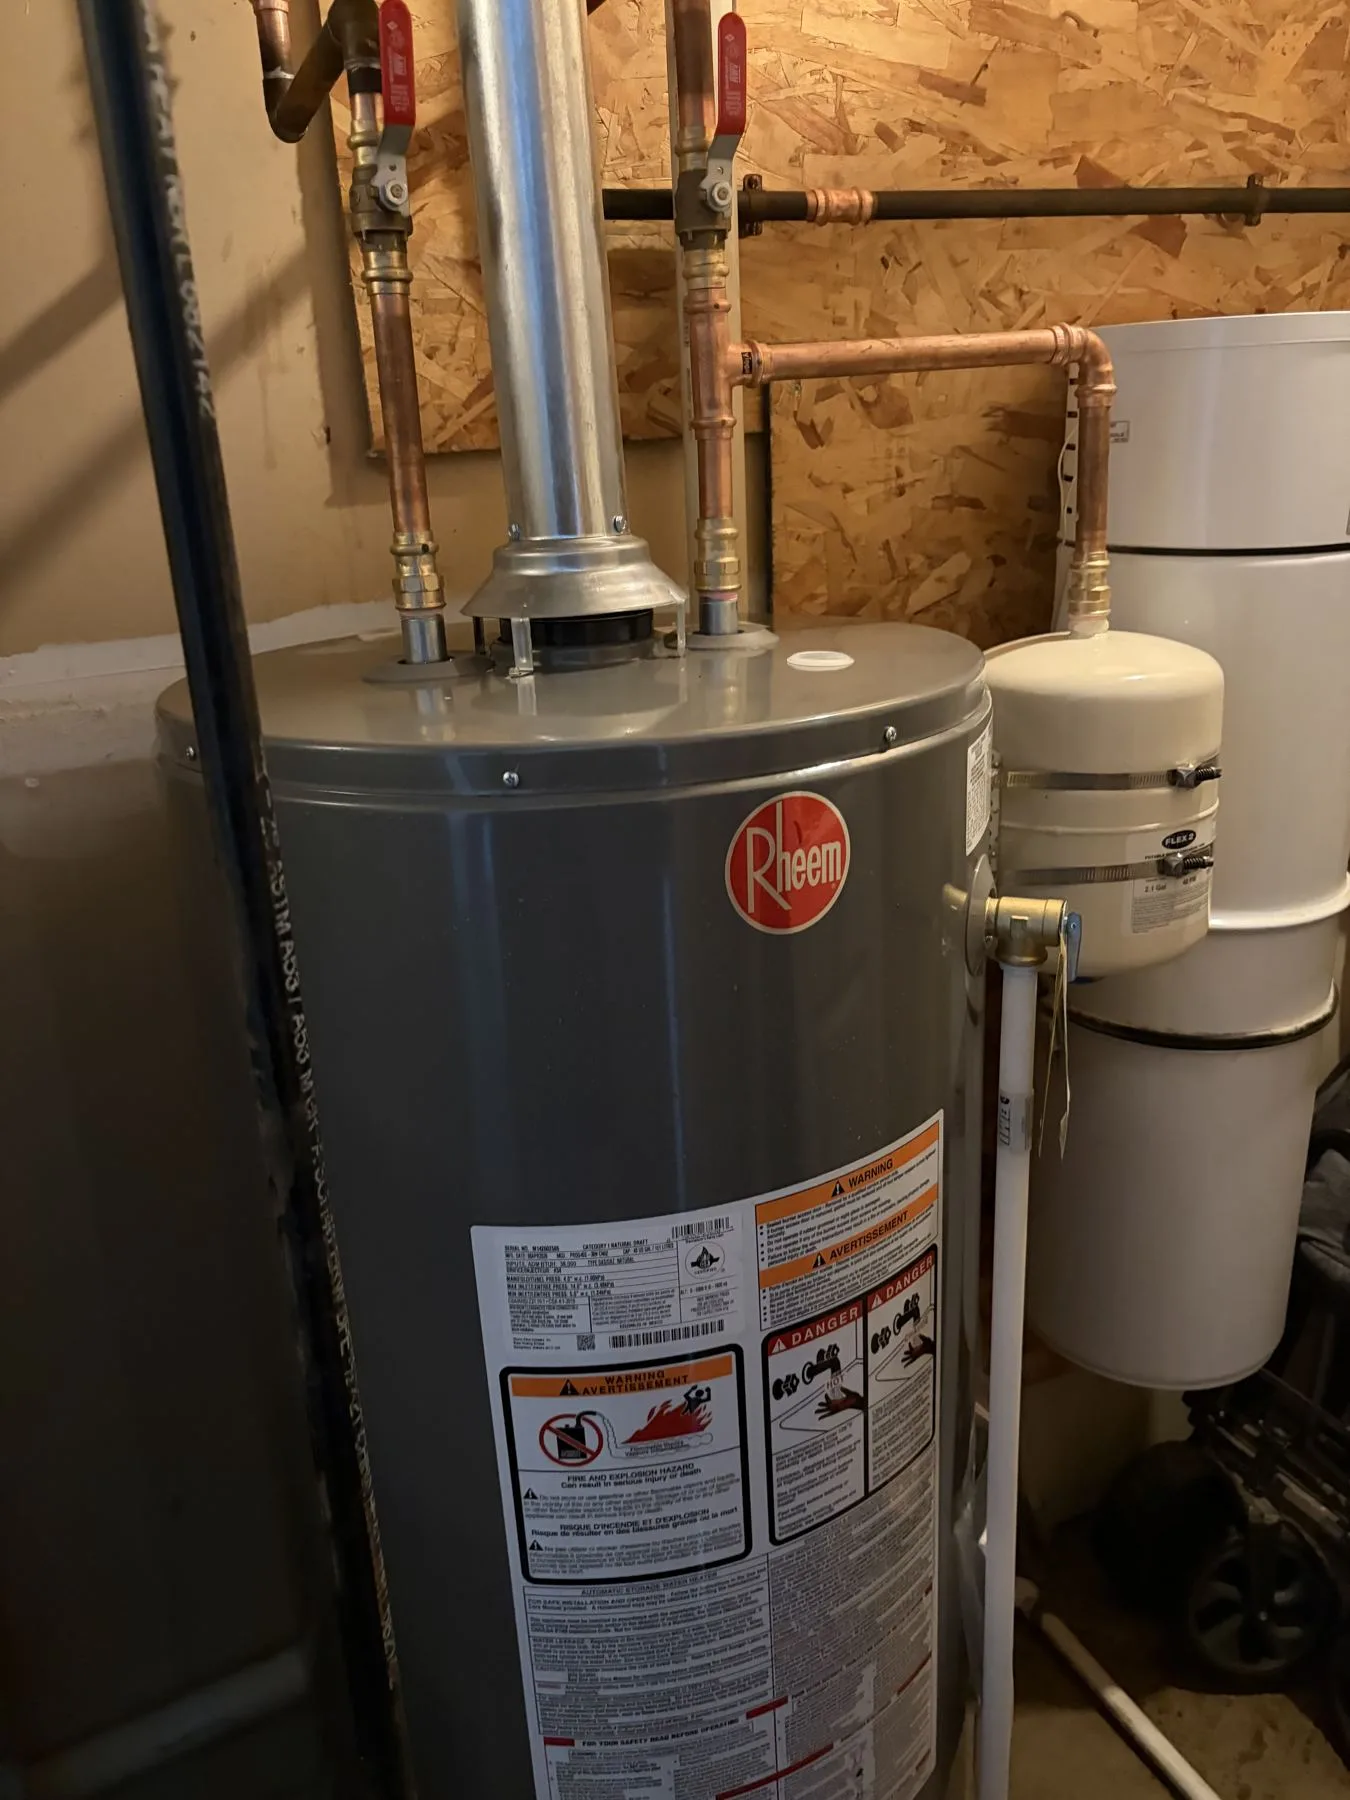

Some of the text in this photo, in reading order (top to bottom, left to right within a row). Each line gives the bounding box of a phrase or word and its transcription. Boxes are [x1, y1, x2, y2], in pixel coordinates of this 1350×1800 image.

[746, 800, 842, 914] Rheem
[848, 1158, 893, 1188] WARNING
[830, 1210, 908, 1260] AVERTISSEMENT
[886, 1255, 933, 1299] DANGER
[791, 1307, 858, 1347] DANGER
[582, 1375, 688, 1395] AVERTISSEMENT
[604, 1370, 665, 1385] WARNING
[561, 1481, 577, 1489] Can
[613, 1478, 643, 1486] serious
[644, 1475, 667, 1484] injury
[679, 1468, 701, 1477] death
[589, 1474, 607, 1482] AND
[609, 1468, 658, 1480] EXPLOSION
[659, 1463, 694, 1474] HAZARD
[531, 1529, 558, 1538] Risque
[672, 1518, 697, 1529] graves
[720, 1506, 738, 1517] mort
[560, 1523, 592, 1531] RISQUE
[593, 1520, 640, 1530] D'INCENDIE
[642, 1518, 652, 1526] ET
[655, 1508, 710, 1522] D'EXPLOSION
